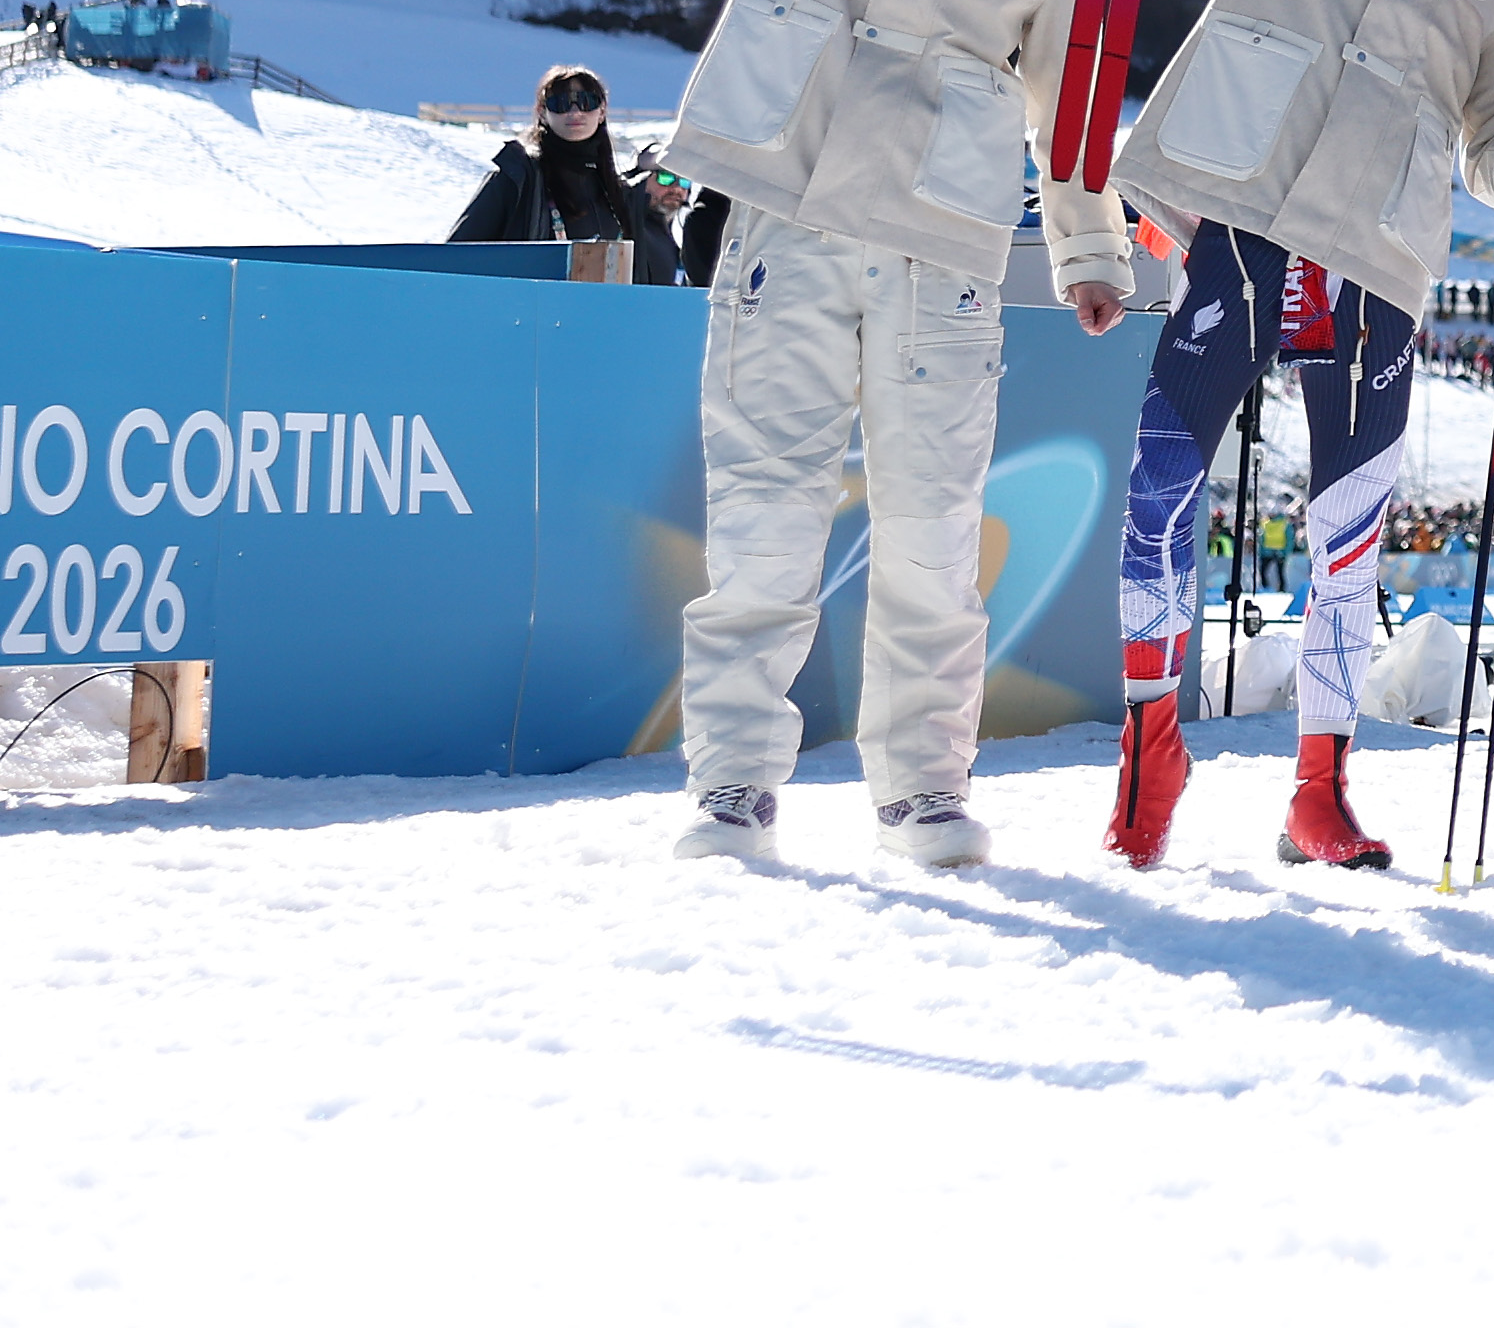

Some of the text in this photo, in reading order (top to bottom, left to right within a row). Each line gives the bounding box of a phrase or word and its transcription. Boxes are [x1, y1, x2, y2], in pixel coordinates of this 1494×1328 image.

[1172, 338, 1207, 356] FRANCE
[0, 404, 473, 516] O CORTINA
[2, 544, 186, 656] 2026
